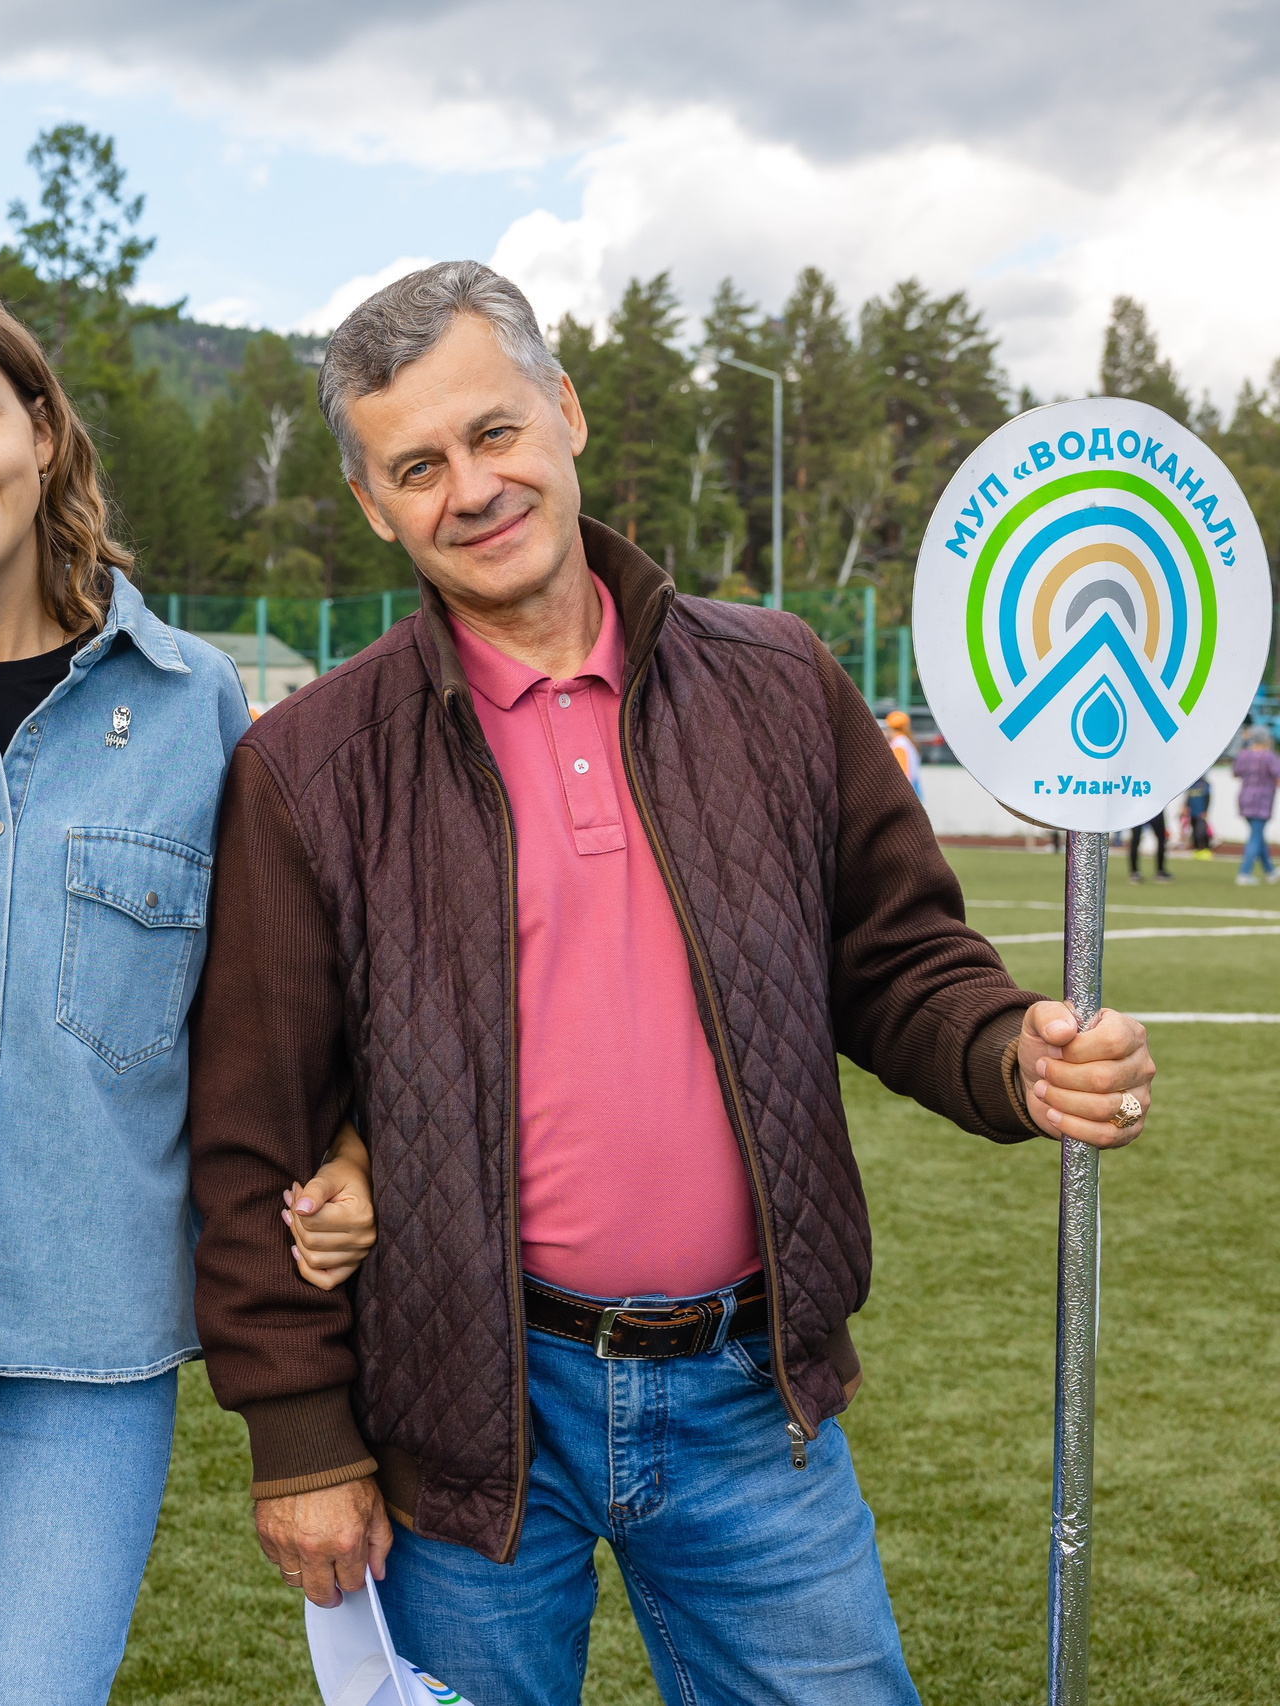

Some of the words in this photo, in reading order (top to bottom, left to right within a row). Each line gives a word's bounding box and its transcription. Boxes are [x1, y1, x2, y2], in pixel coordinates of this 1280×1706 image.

[945, 472, 1009, 559] МУП
[1013, 428, 1236, 567] «ВОДОКАНАЛ»
[1034, 781, 1051, 794] г.
[1057, 775, 1151, 797] Улан-Удэ
